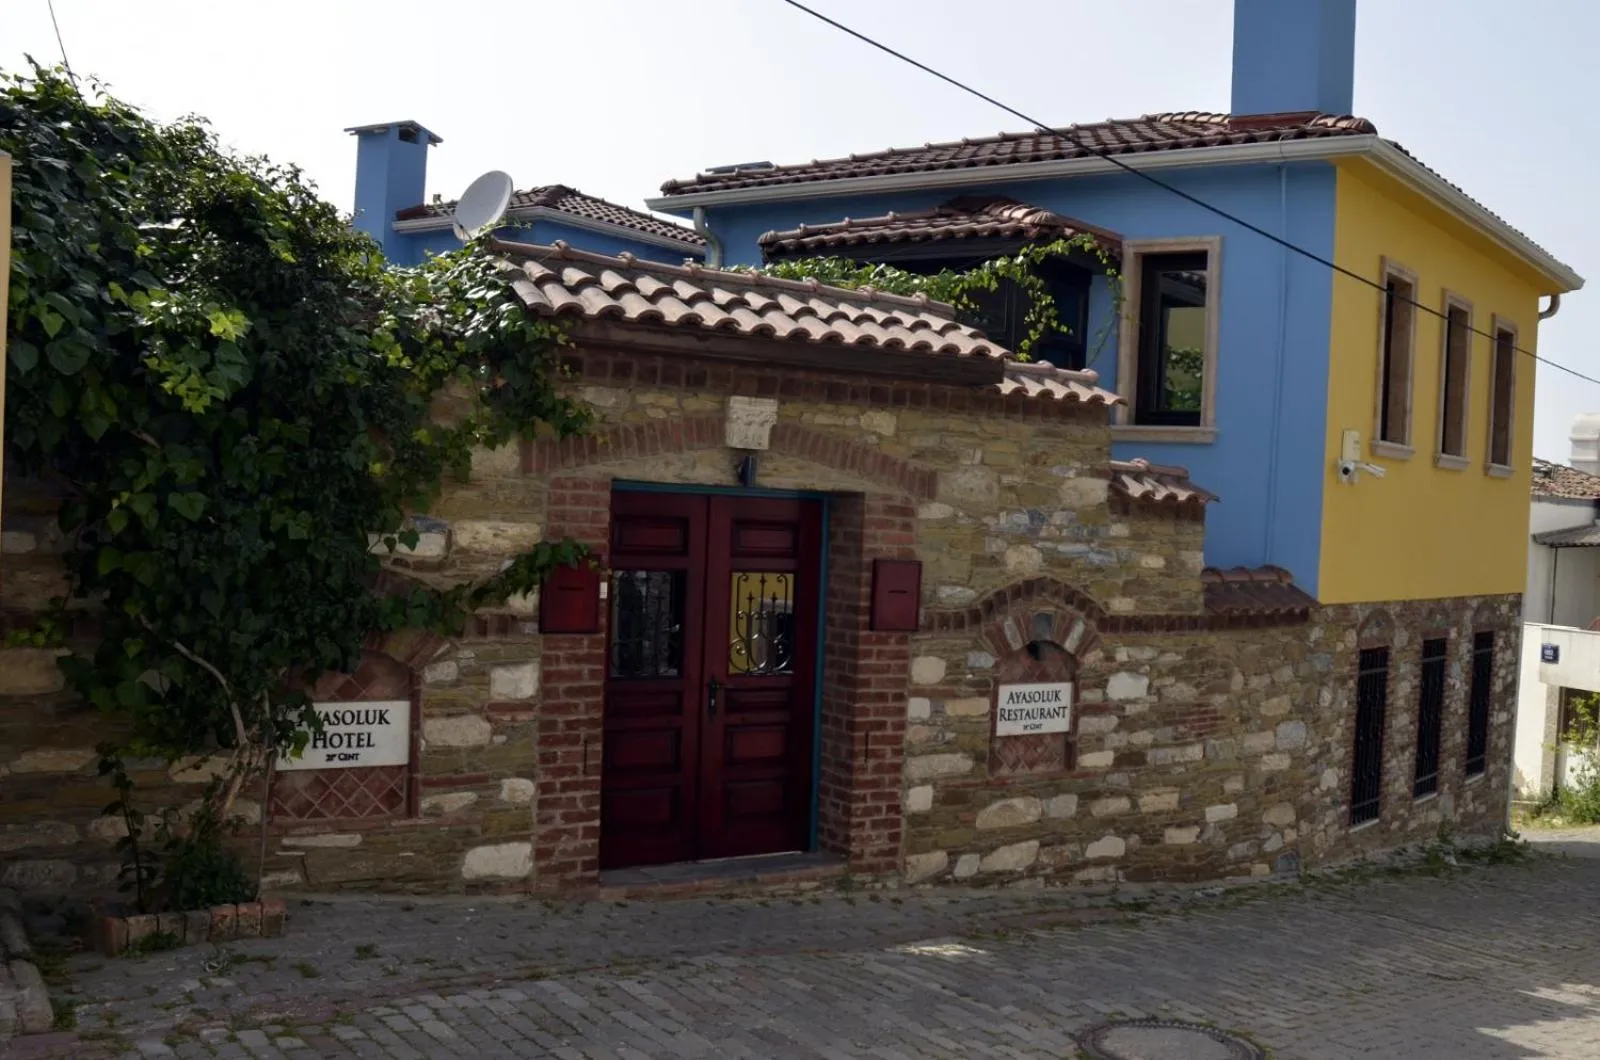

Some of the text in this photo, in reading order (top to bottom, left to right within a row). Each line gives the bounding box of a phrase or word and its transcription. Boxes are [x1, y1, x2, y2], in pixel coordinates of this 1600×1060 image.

[1006, 689, 1062, 705] AYASOLUK
[296, 708, 391, 727] ASOLUK
[999, 706, 1069, 722] RESTAURANT
[311, 731, 375, 749] HOTEL
